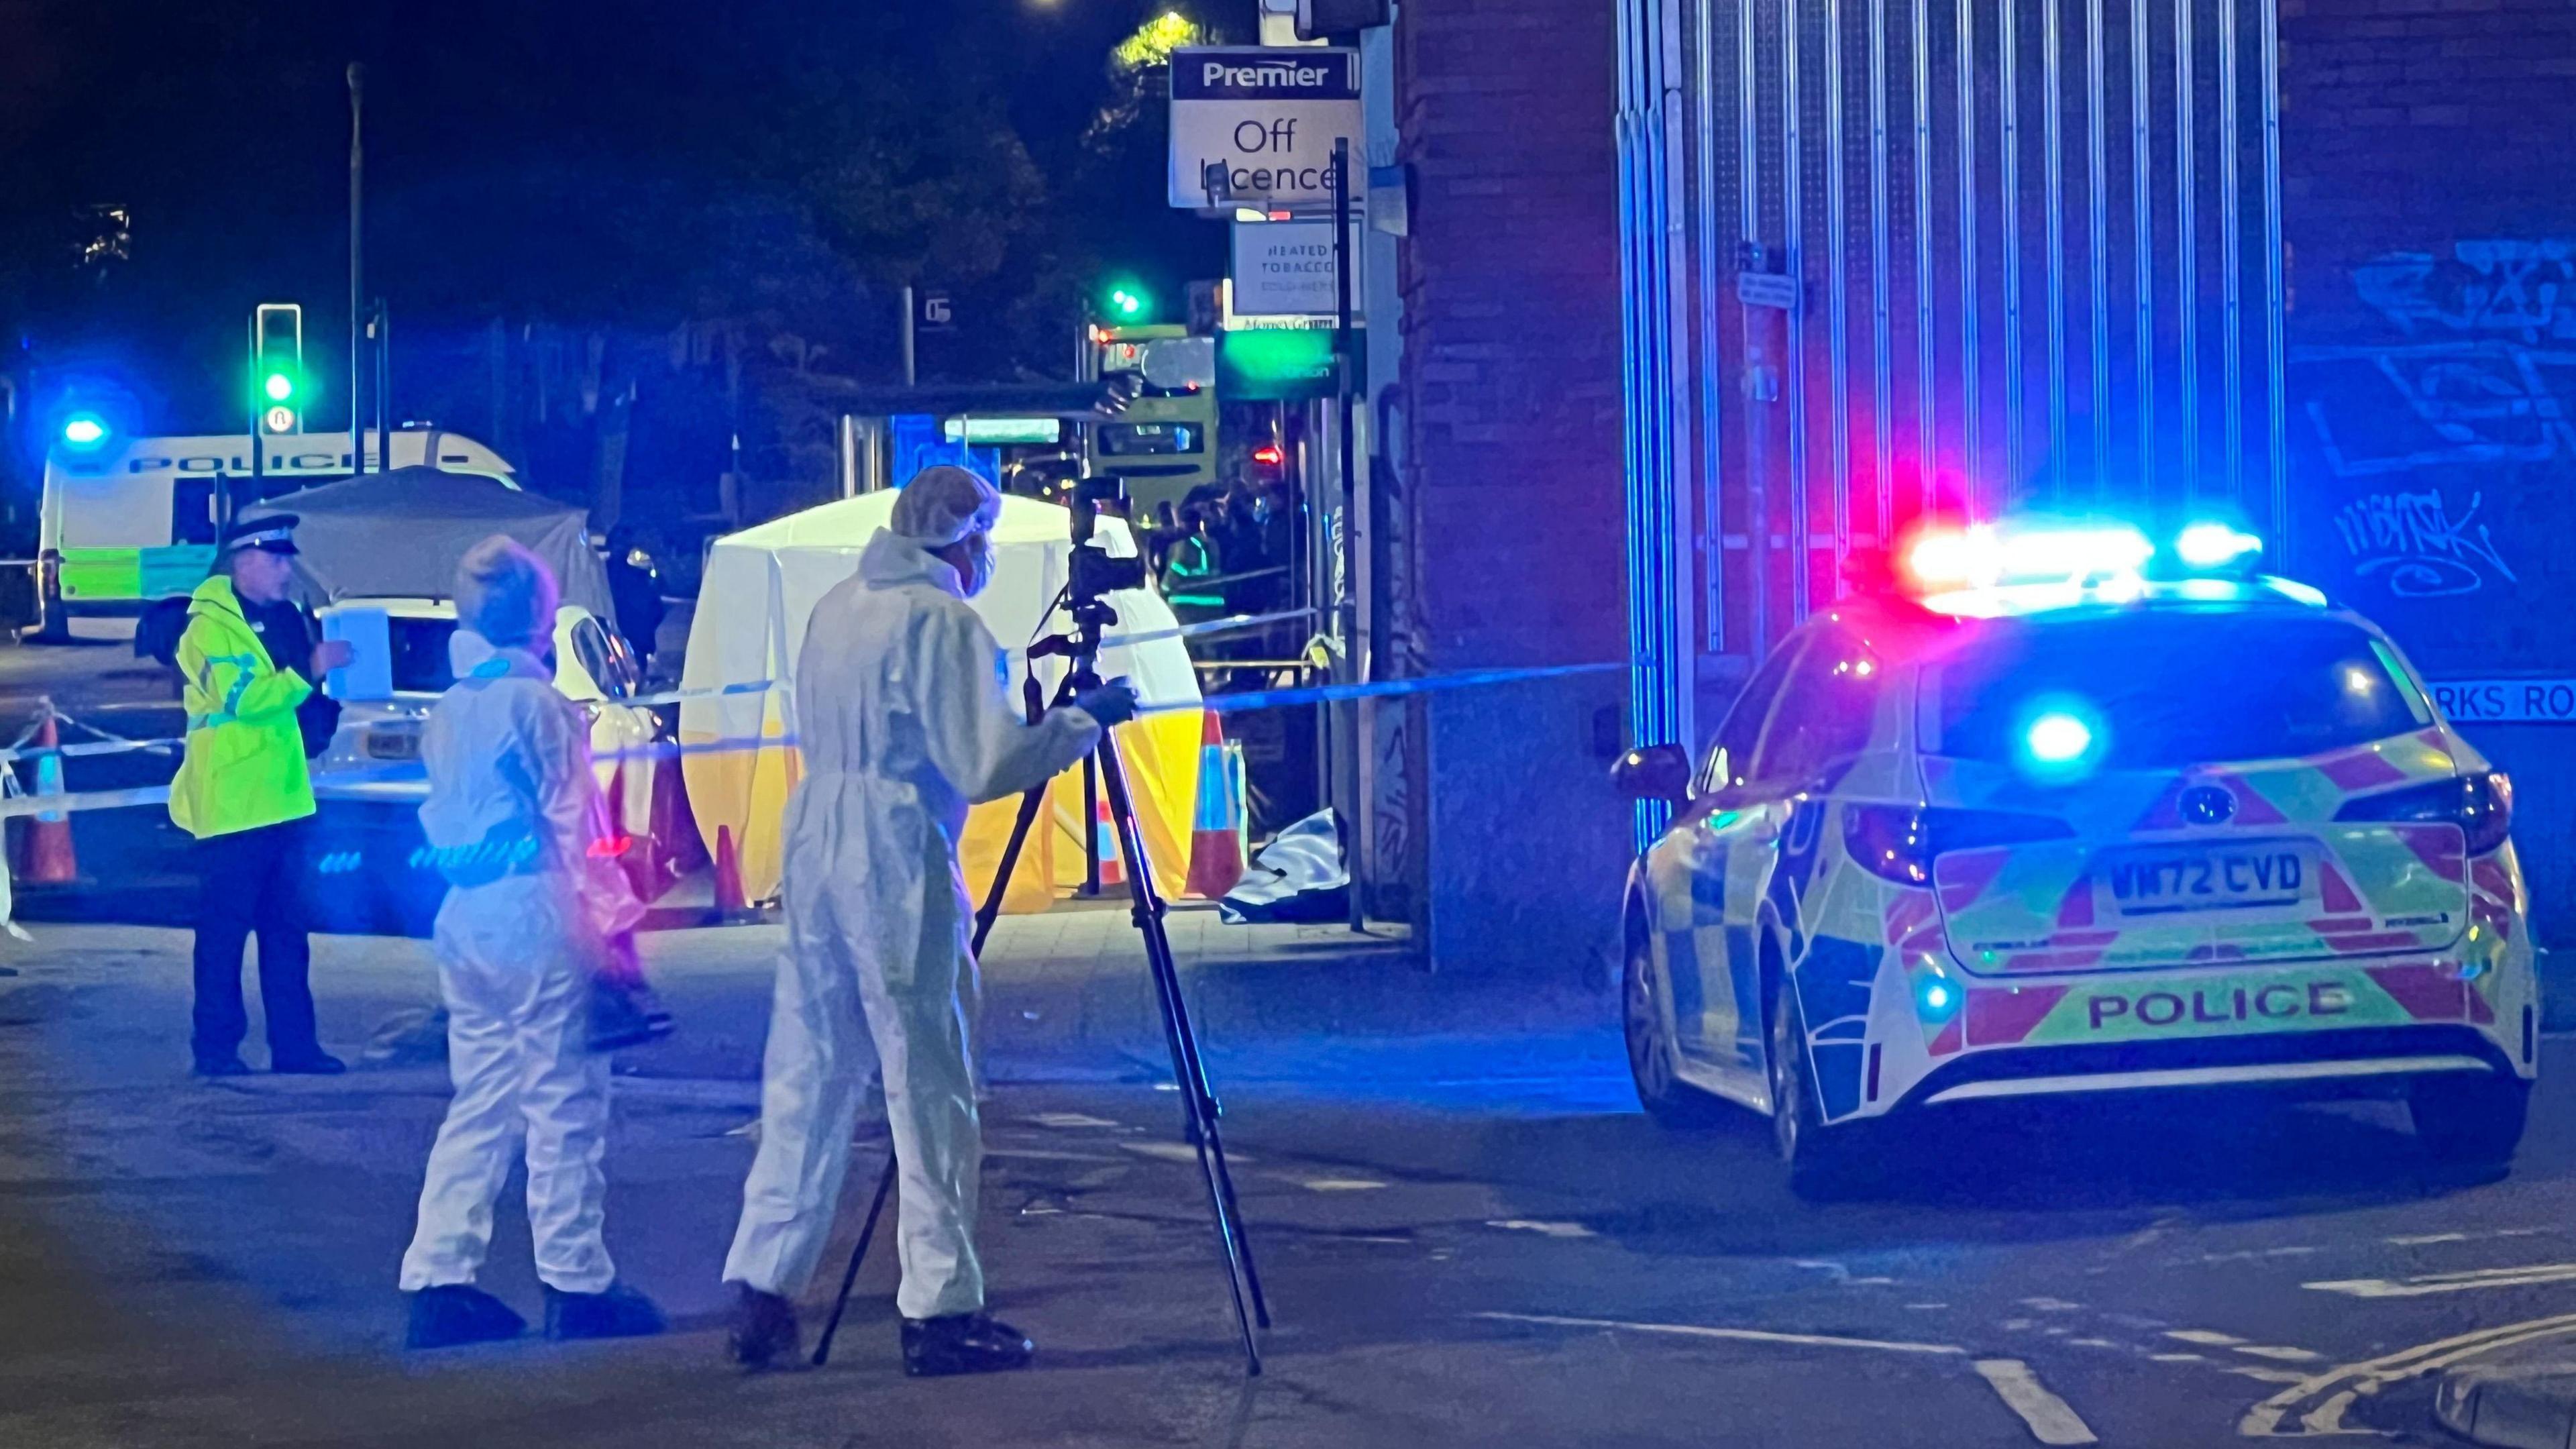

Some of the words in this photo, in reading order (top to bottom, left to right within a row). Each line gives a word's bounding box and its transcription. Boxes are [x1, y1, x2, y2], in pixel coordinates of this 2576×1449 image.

[1203, 60, 1329, 87] Premier
[1234, 118, 1297, 153] Off
[1269, 245, 1328, 256] HEATED
[130, 453, 378, 472] POLICE
[2224, 854, 2301, 892] CVD
[2088, 982, 2348, 1030] POLICE
